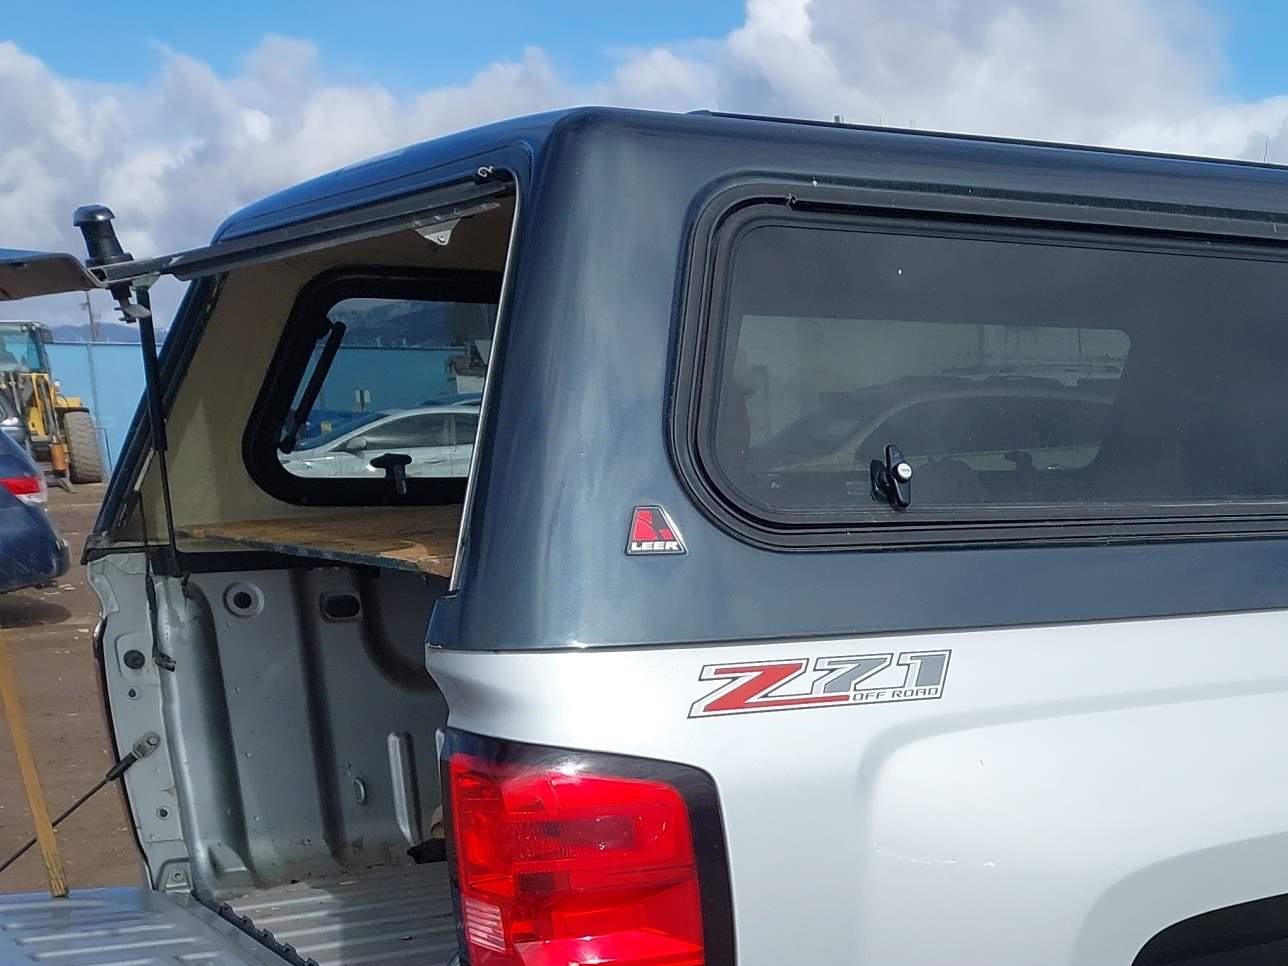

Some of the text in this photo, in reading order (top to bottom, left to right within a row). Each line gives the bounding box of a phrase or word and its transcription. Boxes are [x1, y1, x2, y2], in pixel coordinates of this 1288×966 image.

[631, 541, 679, 551] LEER
[687, 649, 952, 719] Z71
[853, 687, 938, 701] OFF ROAD
